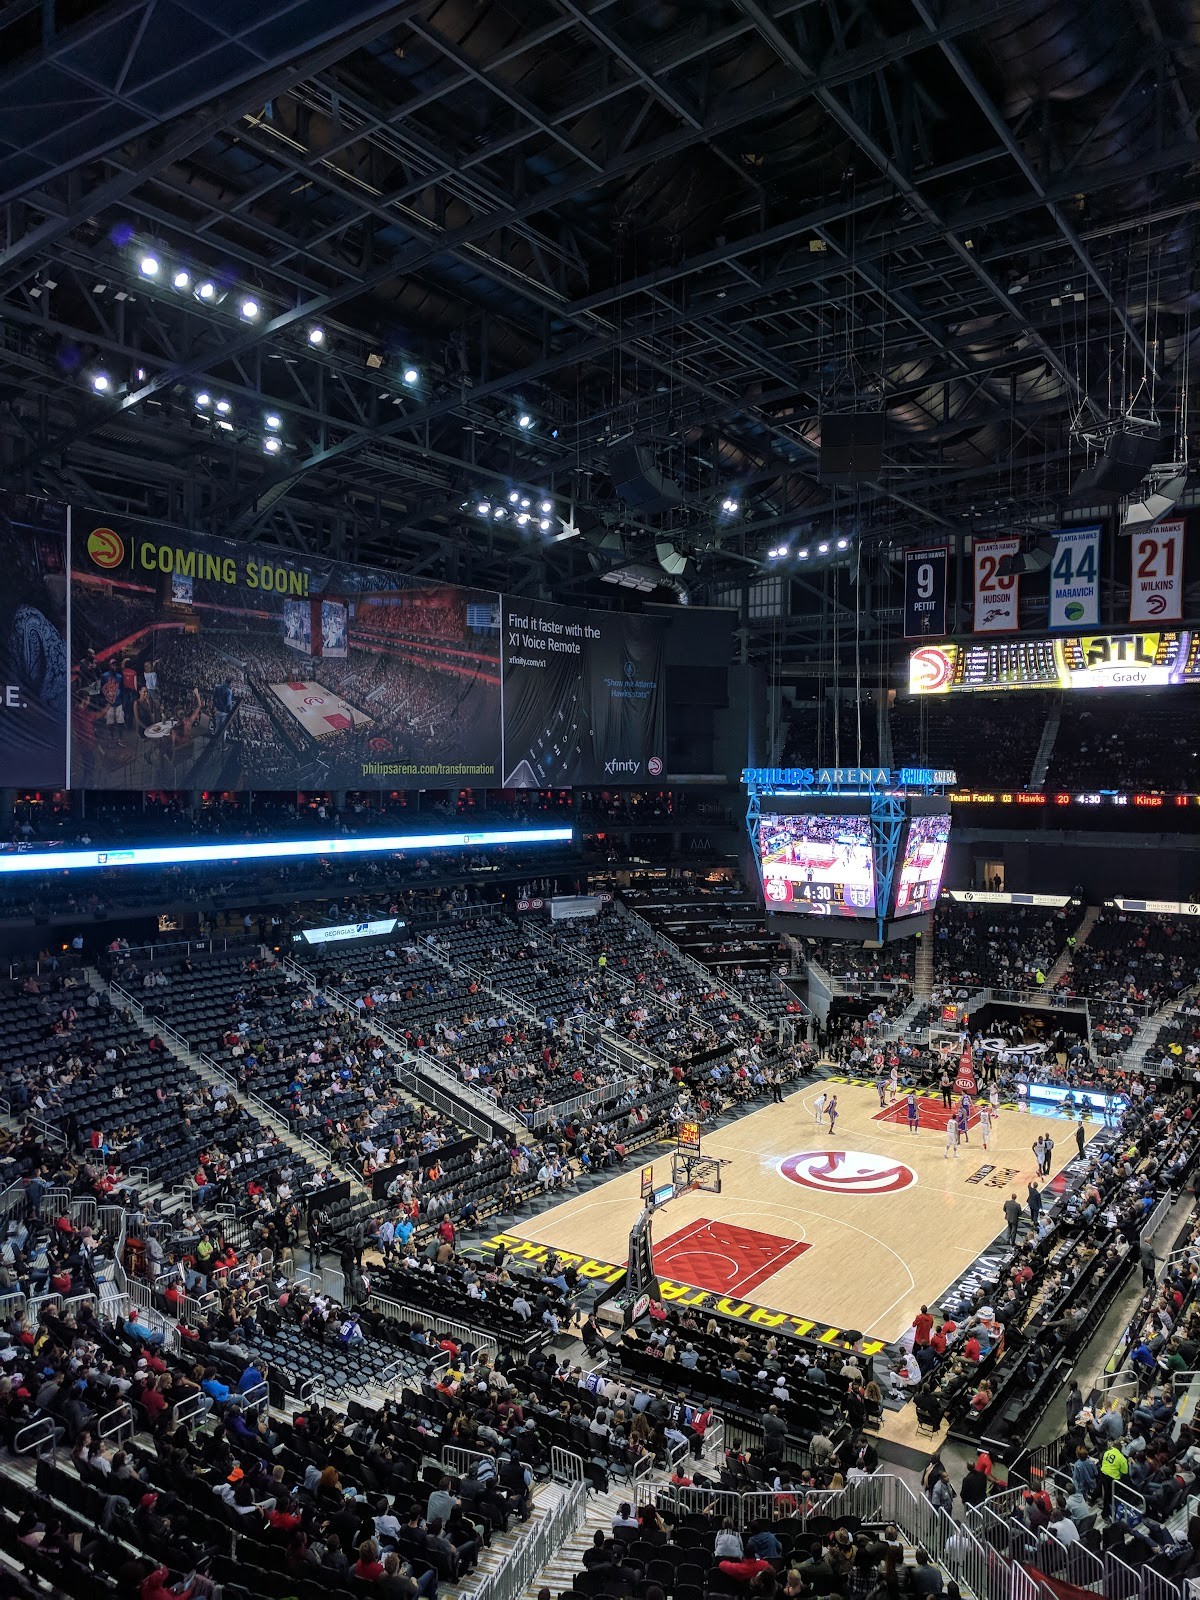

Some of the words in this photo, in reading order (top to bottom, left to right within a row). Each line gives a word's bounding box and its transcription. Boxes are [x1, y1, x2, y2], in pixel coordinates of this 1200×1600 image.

[1160, 525, 1182, 533] HAWKS
[1078, 533, 1097, 541] HAWKS
[999, 543, 1017, 551] HAWKS
[915, 552, 927, 560] LOUIS
[1137, 538, 1176, 579] 21
[141, 542, 236, 585] COMING
[246, 562, 309, 597] SOON!
[1053, 545, 1097, 585] 44
[917, 564, 934, 598] 9
[1141, 580, 1174, 592] WILKINS
[983, 594, 1011, 604] HUDSON
[1055, 587, 1094, 599] MARAVICH
[914, 601, 936, 611] PETTIT
[508, 613, 528, 629] Find
[530, 617, 537, 631] it
[539, 618, 563, 634] faster
[565, 623, 583, 637] with
[584, 625, 601, 639] the
[508, 632, 520, 646] X1
[522, 634, 546, 650] Voice
[547, 638, 581, 654] Remote
[1087, 636, 1154, 667] ATL
[508, 656, 546, 667] xfinity.com/x1
[1112, 672, 1147, 683] Grady
[634, 680, 656, 688] Atlanta
[0, 685, 28, 708] E.
[611, 690, 631, 698] Hawks
[362, 763, 494, 777] philipsarena.com/transformation
[604, 758, 641, 775] xfinity
[741, 768, 814, 785] PHILIPS
[820, 769, 889, 784] ARENA
[949, 793, 970, 802] Team
[972, 794, 995, 803] Fouls
[1002, 794, 1012, 803] 03
[1018, 794, 1045, 803] Hawks
[1057, 795, 1070, 804] 20
[1078, 795, 1101, 804] 4:30
[1113, 795, 1128, 804] 1st
[1136, 796, 1162, 806] Kings
[1176, 796, 1188, 805] 11
[803, 885, 831, 901] 4:30
[325, 928, 356, 938] GEORGIA'S
[672, 1410, 680, 1421] 5
